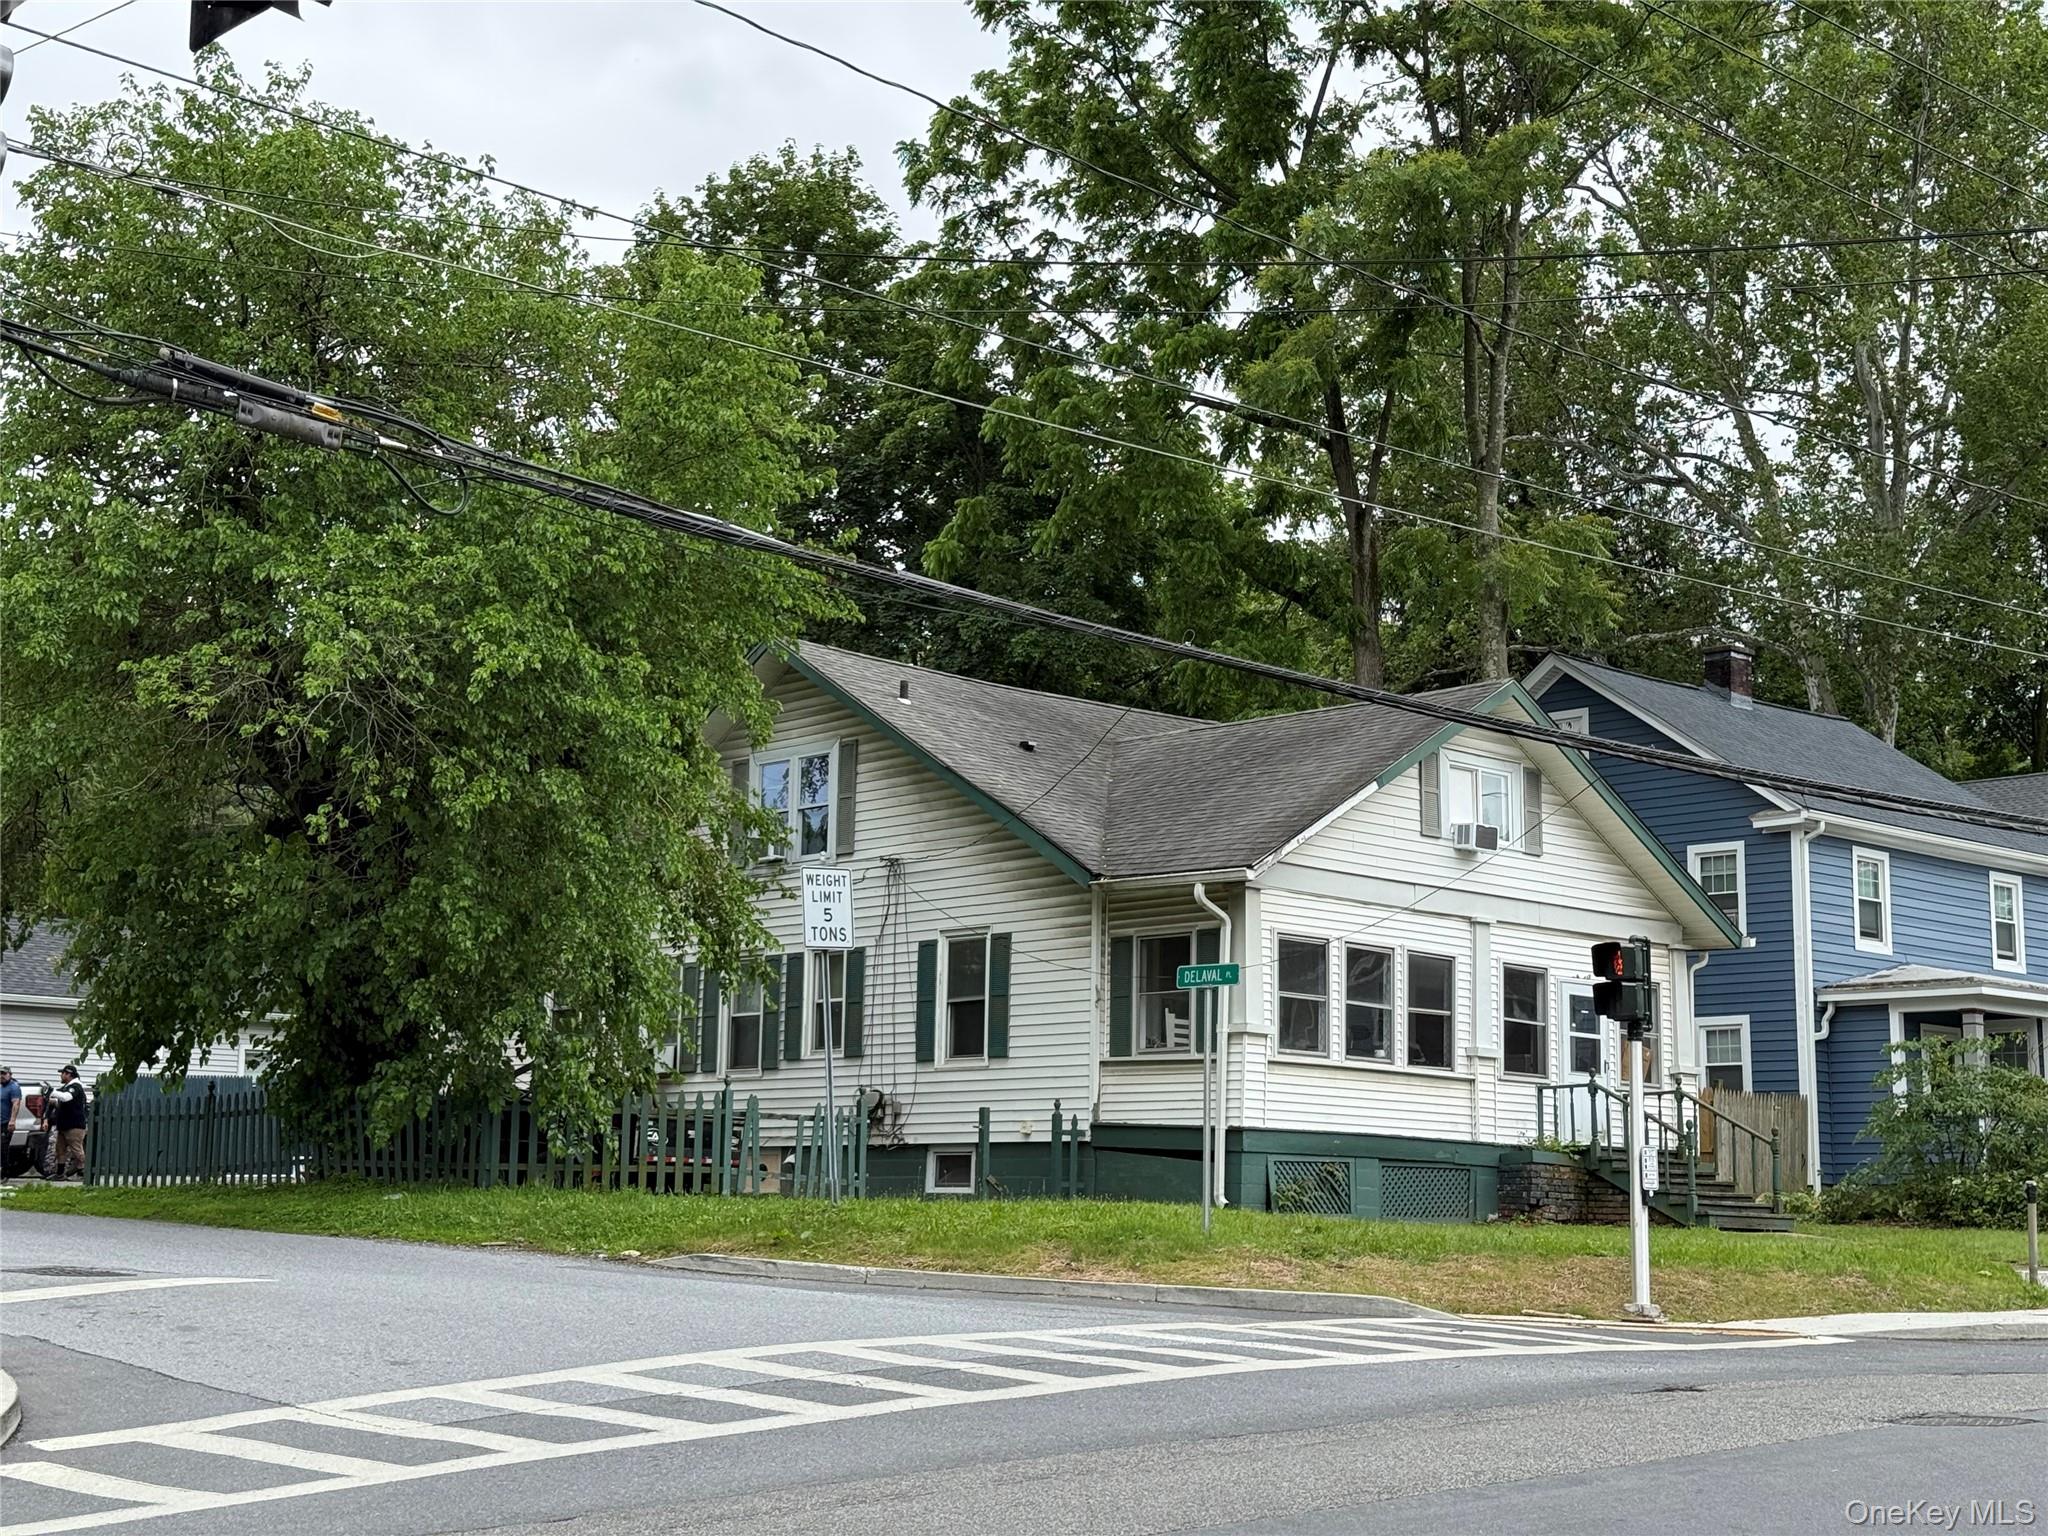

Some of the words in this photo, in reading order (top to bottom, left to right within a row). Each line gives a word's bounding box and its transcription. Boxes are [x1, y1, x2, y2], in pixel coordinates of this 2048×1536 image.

[806, 874, 847, 887] WEIGHT
[811, 890, 843, 903] LIMIT
[823, 908, 833, 922] 5
[811, 926, 847, 942] TONS
[1184, 969, 1222, 983] DELAVAL
